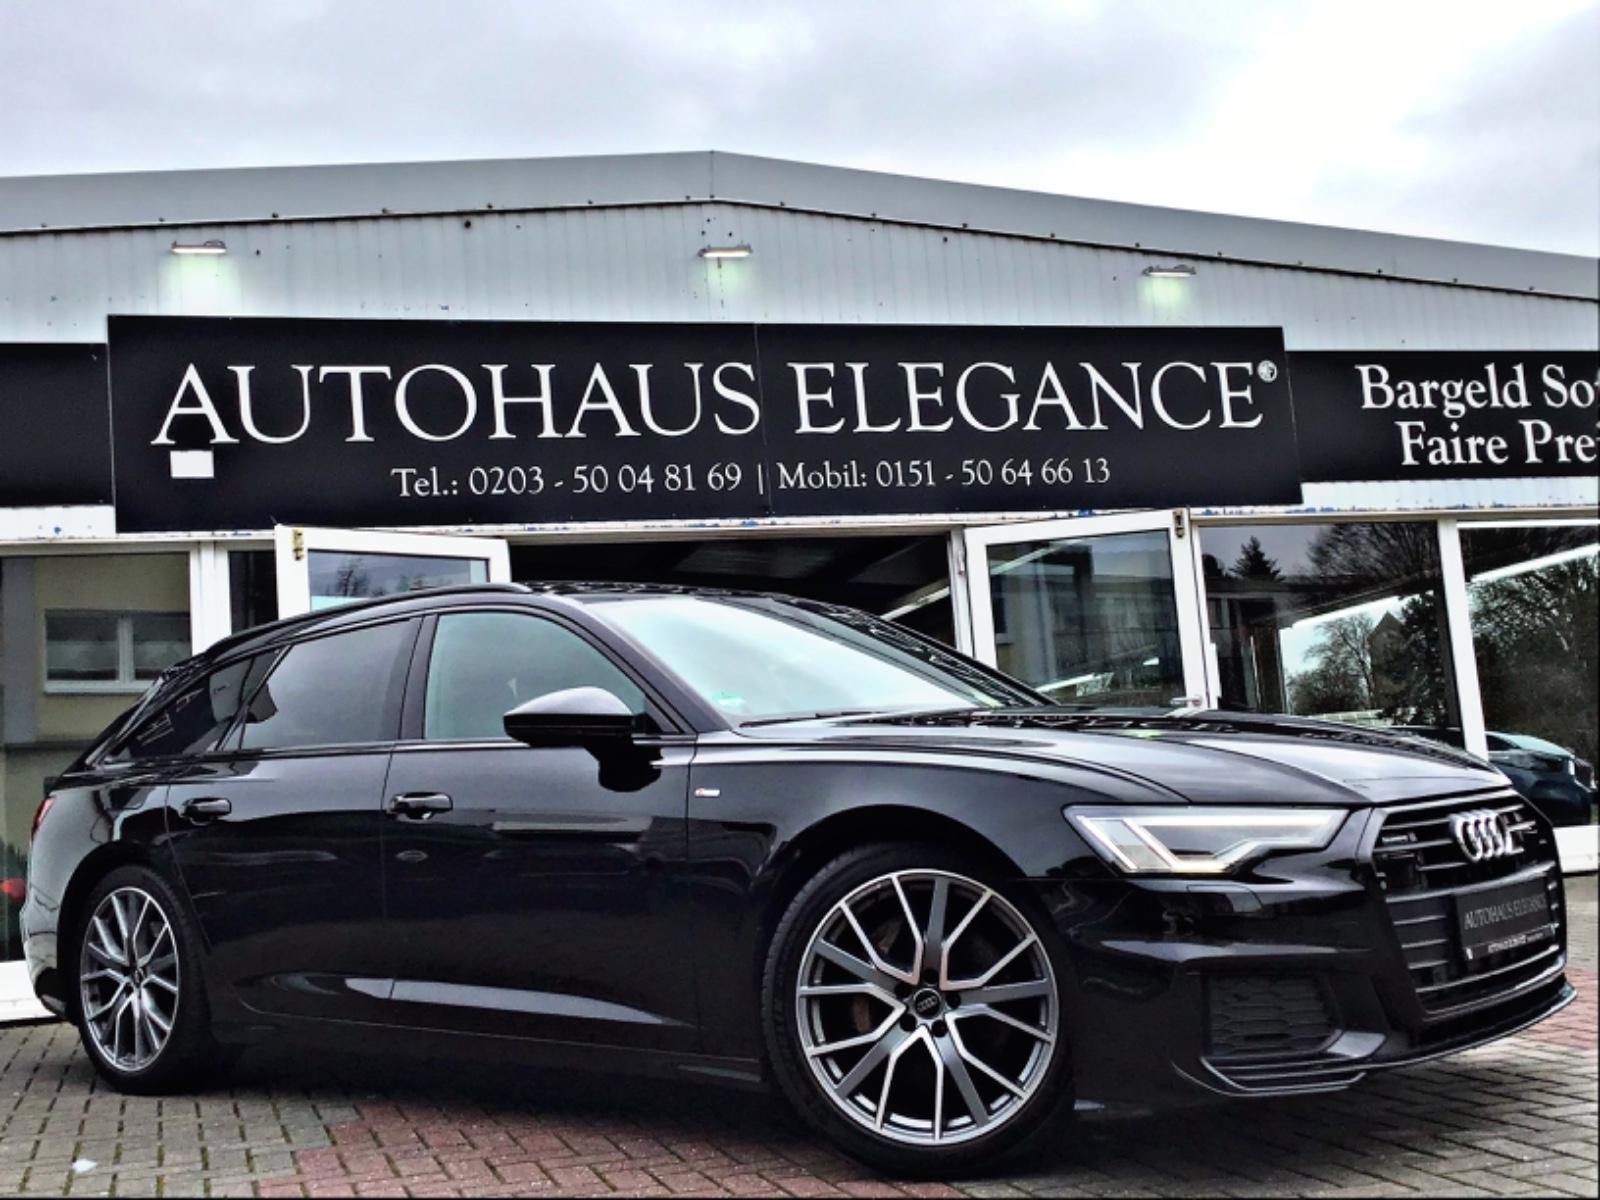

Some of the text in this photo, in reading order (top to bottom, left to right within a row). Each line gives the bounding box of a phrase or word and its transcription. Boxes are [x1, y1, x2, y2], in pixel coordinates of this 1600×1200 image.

[150, 360, 1264, 446] AUTOHAUS ELEGANCE
[1354, 362, 1532, 419] Bargeld
[1394, 418, 1598, 466] Faire Pre
[391, 467, 459, 497] Tel.:
[468, 465, 545, 495] 0203
[572, 464, 610, 493] 50
[617, 463, 655, 493] 04
[663, 463, 697, 492] 81
[706, 462, 743, 491] 69
[776, 459, 868, 490] Mobil:
[875, 459, 936, 487] 0151
[961, 458, 994, 486] 50
[1000, 458, 1034, 486] 64
[1040, 457, 1074, 485] 66
[1082, 457, 1111, 483] 13
[1463, 903, 1514, 930] AUTOHAUS
